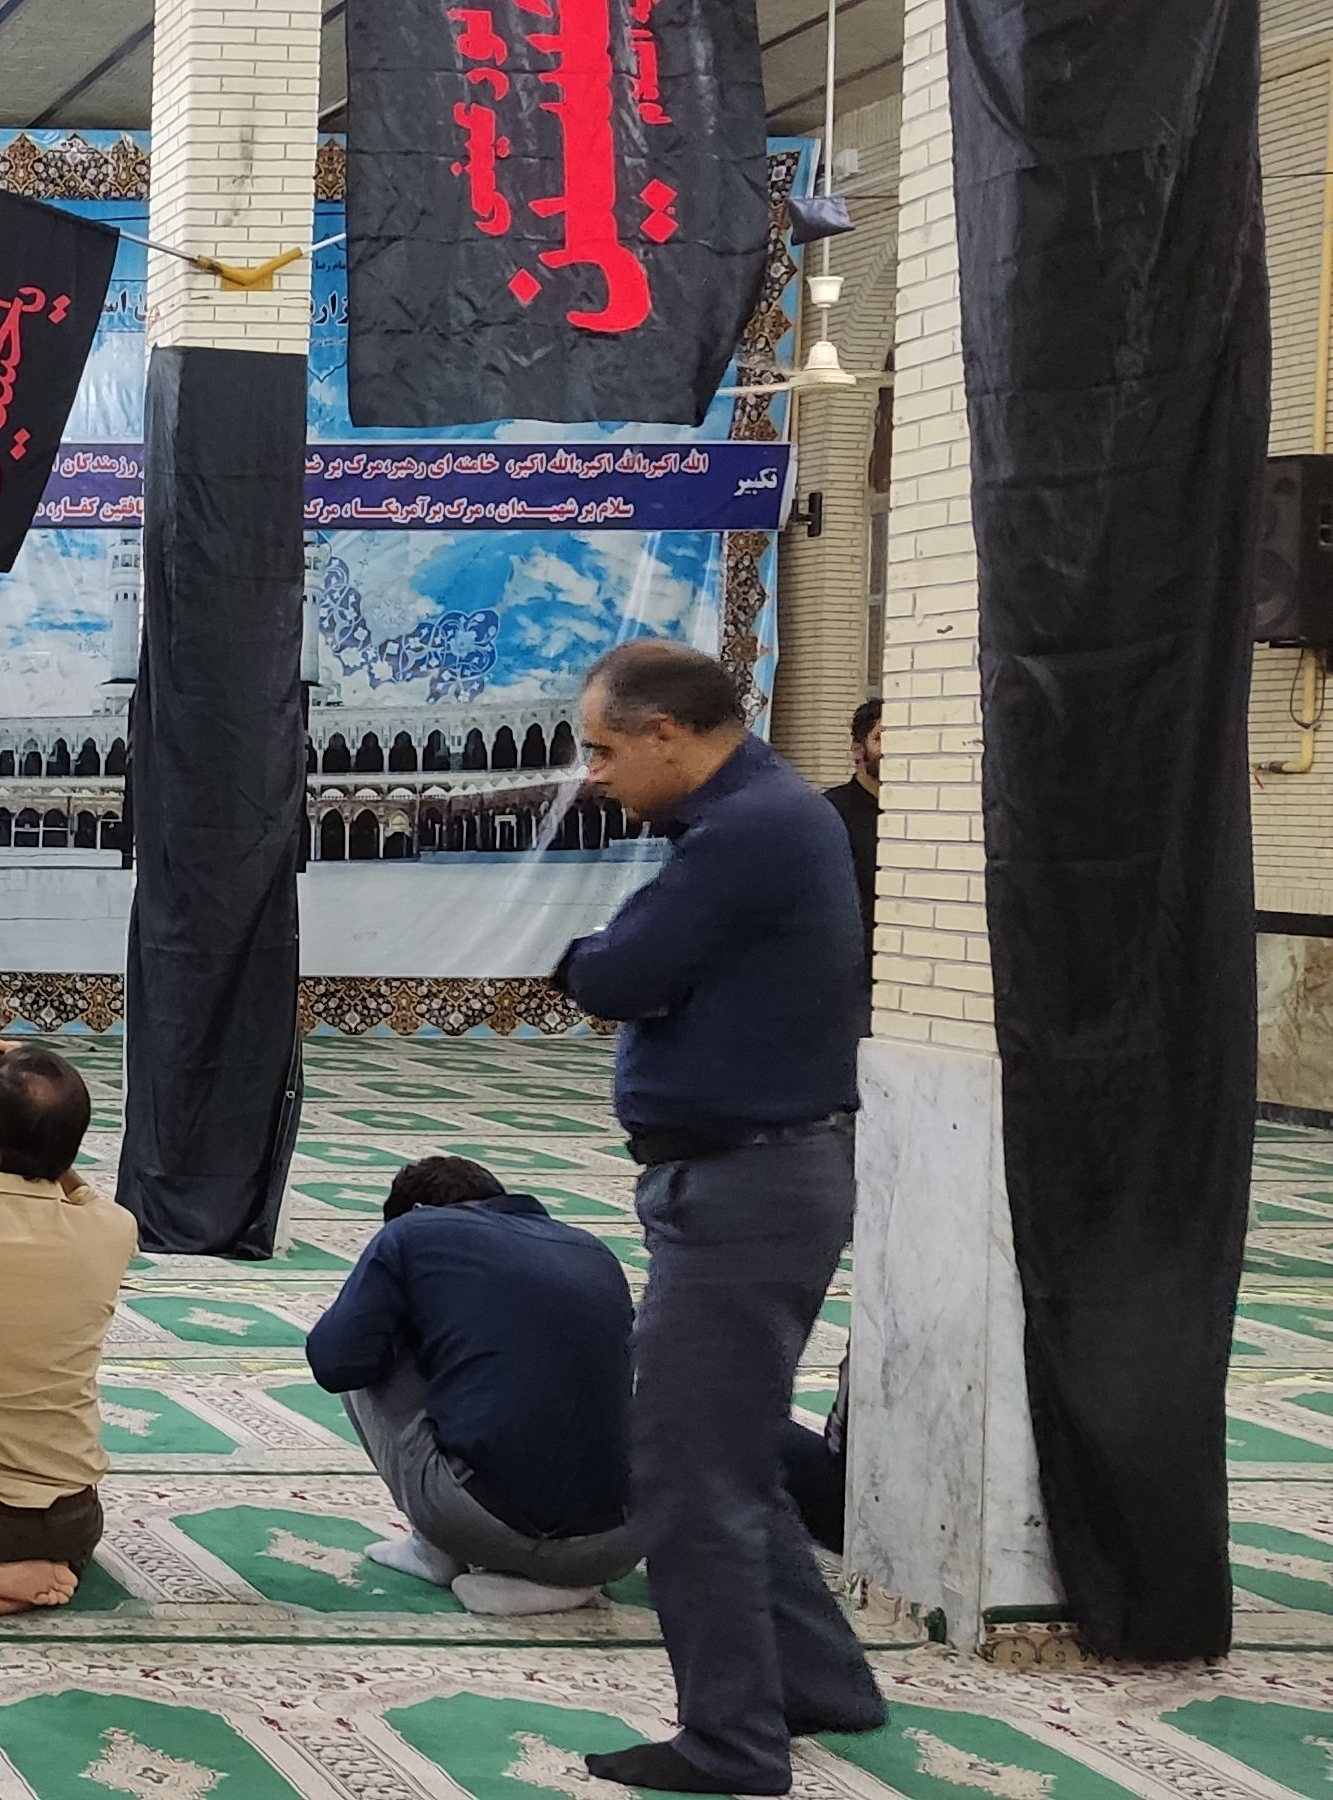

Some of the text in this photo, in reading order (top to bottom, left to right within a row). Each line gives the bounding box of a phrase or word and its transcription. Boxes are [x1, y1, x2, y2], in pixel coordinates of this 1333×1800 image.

[508, 0, 679, 333] سین
[60, 451, 138, 478] رزمندگان
[324, 457, 343, 479] بر
[428, 453, 453, 479] ای
[453, 453, 499, 475] خامنه
[548, 449, 576, 474] الله
[615, 449, 645, 474] الله
[682, 449, 709, 474] الله
[734, 468, 778, 497] تکبیر
[577, 501, 597, 523] بر
[599, 496, 635, 523] سلام
